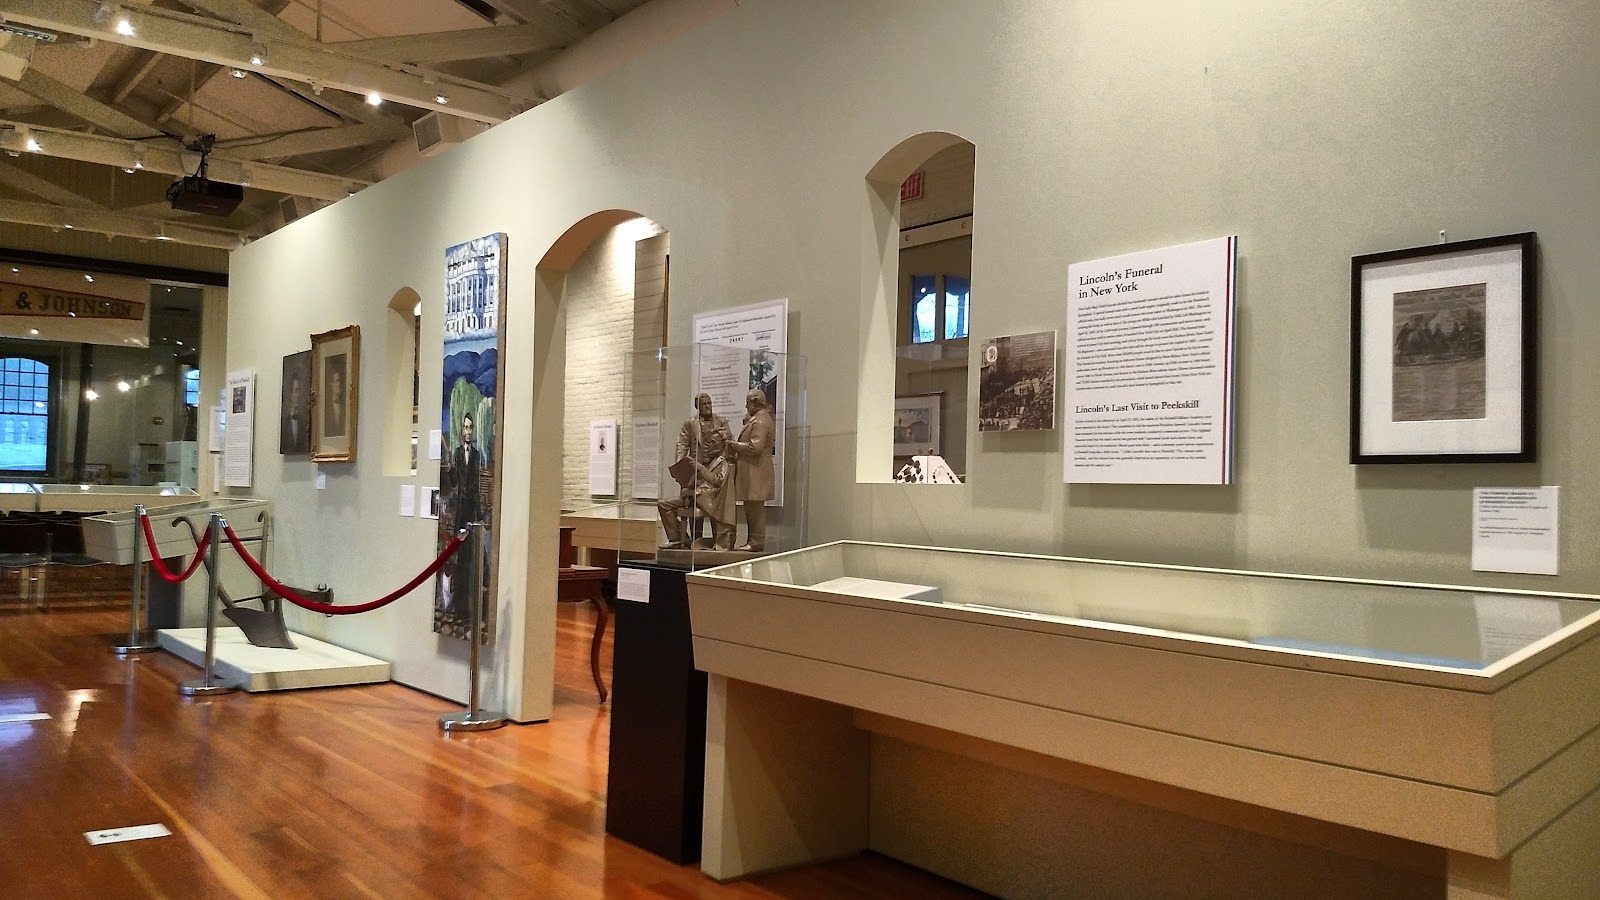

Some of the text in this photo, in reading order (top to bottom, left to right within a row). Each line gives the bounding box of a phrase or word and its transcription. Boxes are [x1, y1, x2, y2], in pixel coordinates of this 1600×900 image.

[1079, 264, 1163, 286] Lincoln's Funeral
[1079, 282, 1138, 299] in New York
[16, 292, 132, 316] & JOHNSON
[1075, 400, 1199, 413] Lincoln's Last Visit to Peekskill
